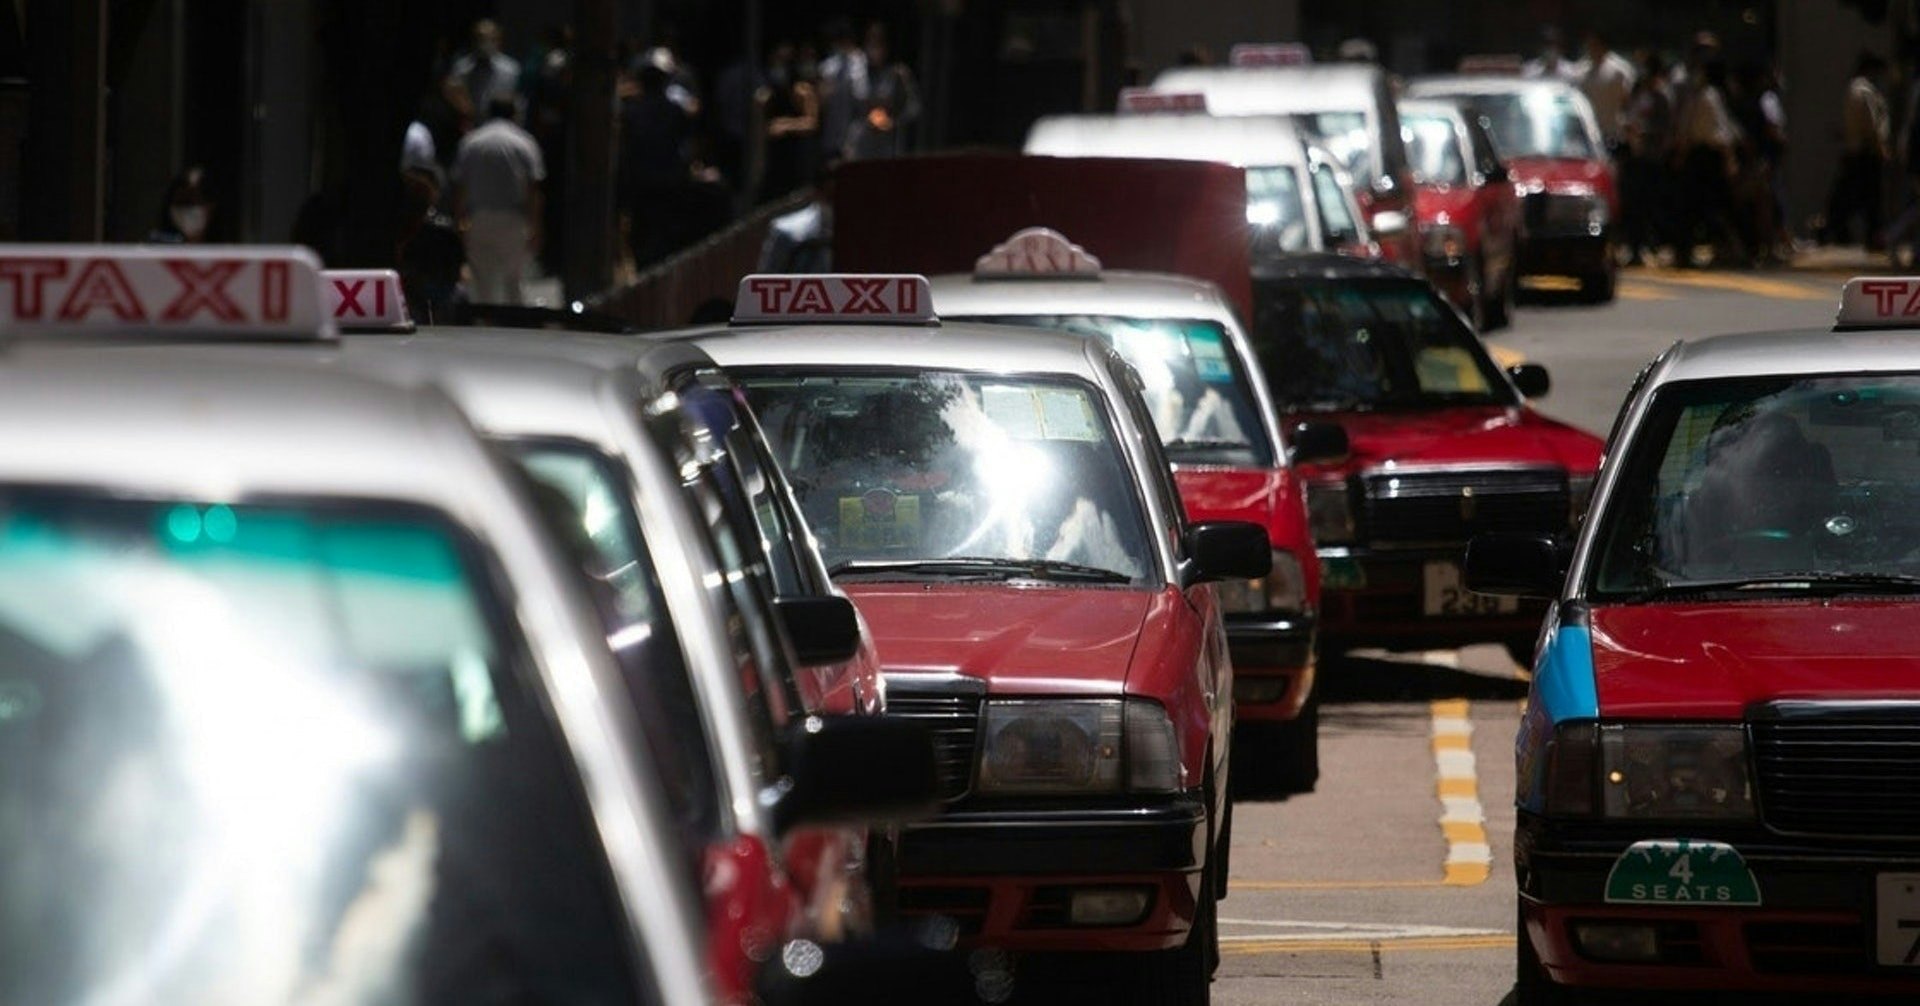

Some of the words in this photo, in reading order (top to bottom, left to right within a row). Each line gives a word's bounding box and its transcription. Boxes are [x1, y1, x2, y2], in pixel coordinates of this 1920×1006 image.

[0, 257, 292, 322] TAXI
[333, 280, 386, 317] XI
[751, 278, 918, 314] TAXI
[1668, 853, 1694, 885] 4
[1632, 883, 1731, 900] SEATS
